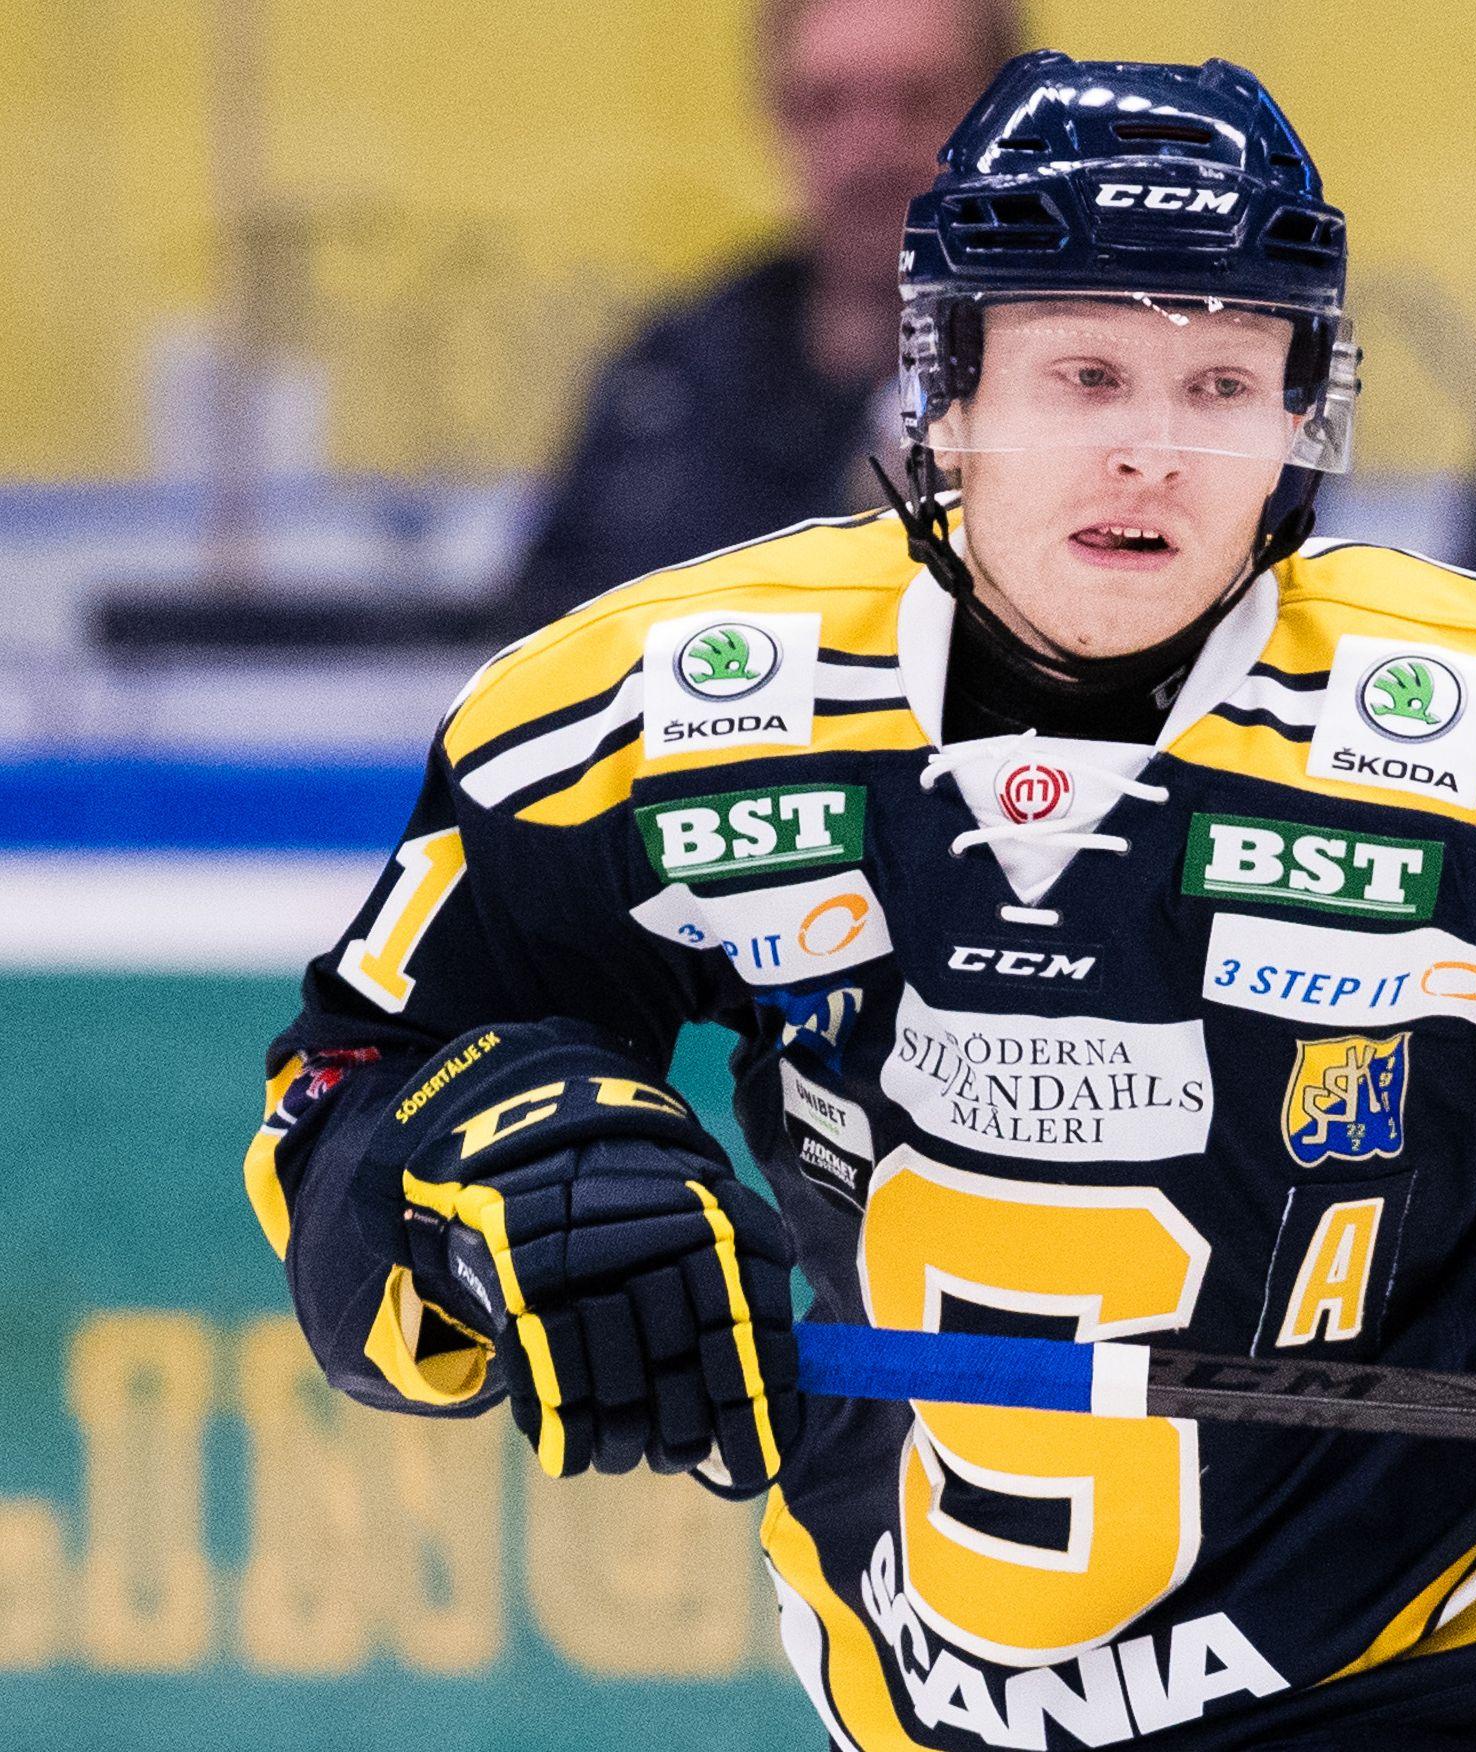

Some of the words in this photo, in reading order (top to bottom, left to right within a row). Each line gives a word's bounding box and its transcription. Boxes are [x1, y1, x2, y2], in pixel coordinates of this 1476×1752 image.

[1095, 184, 1239, 215] CCM
[663, 713, 788, 743] ŠKODA
[1331, 747, 1459, 794] ŠKODA
[655, 789, 846, 868] BST
[1203, 823, 1424, 904] BST
[679, 923, 705, 943] 3
[751, 934, 781, 969] IT
[947, 945, 1096, 981] CCM
[1215, 959, 1240, 987] 3
[1250, 965, 1361, 1005] STEP
[1369, 971, 1411, 1009] IT
[395, 1038, 482, 1124] SÖDERTÄLJE
[478, 1030, 501, 1053] SK
[899, 1027, 1205, 1113] SILJENDAHLS
[796, 1079, 846, 1127] UNIBET
[951, 1100, 1106, 1143] MÅLERI
[802, 1137, 858, 1181] HOCKEY
[1276, 1197, 1385, 1348] A
[860, 1530, 1291, 1752] SCANIA
